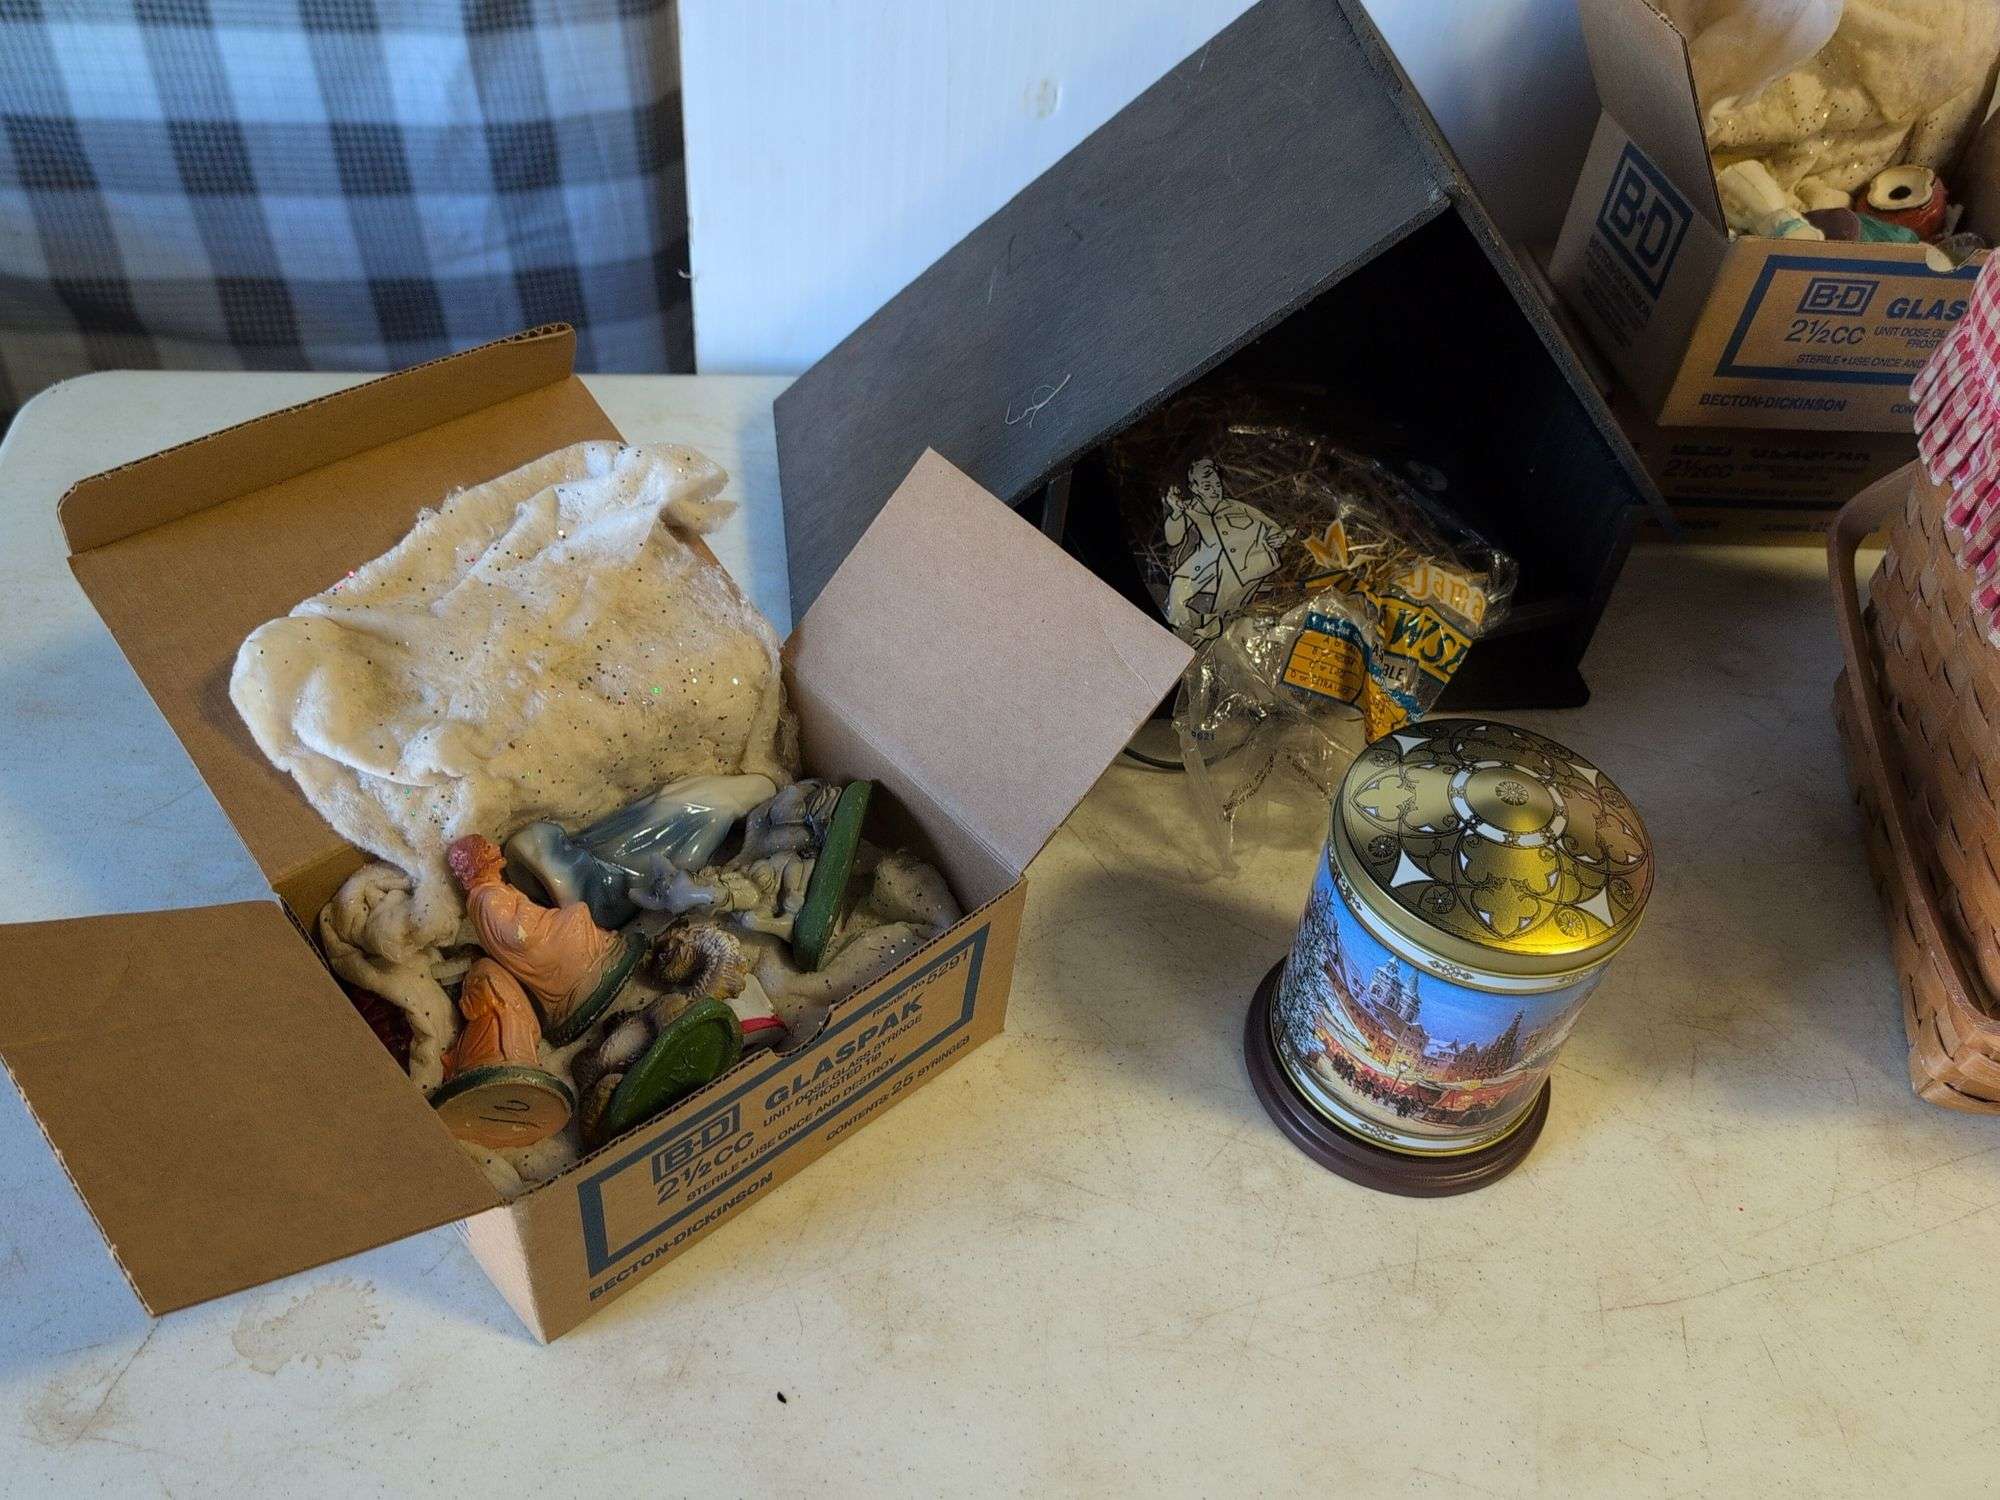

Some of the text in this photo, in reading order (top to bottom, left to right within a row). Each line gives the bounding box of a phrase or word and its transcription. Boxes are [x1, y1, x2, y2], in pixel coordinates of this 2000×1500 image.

[1886, 297, 1968, 321] GLAS
[1873, 325, 1902, 338] UNIT
[1902, 327, 1932, 339] DOSE
[1796, 353, 1842, 366] STERILE
[1698, 392, 1848, 413] BECTON-DICKINSON
[925, 949, 969, 986] 5291
[763, 1013, 923, 1128] UNIT DOSE GLASS SYRINGE
[764, 992, 924, 1110] GLASPAK
[890, 1071, 914, 1097] 25
[916, 1034, 970, 1078] SYRINGES
[806, 1064, 863, 1107] FROSTED
[686, 1053, 897, 1202] STERILE USE ONCE AND DESTROY
[589, 1171, 773, 1300] BECTON-DICKINSON
